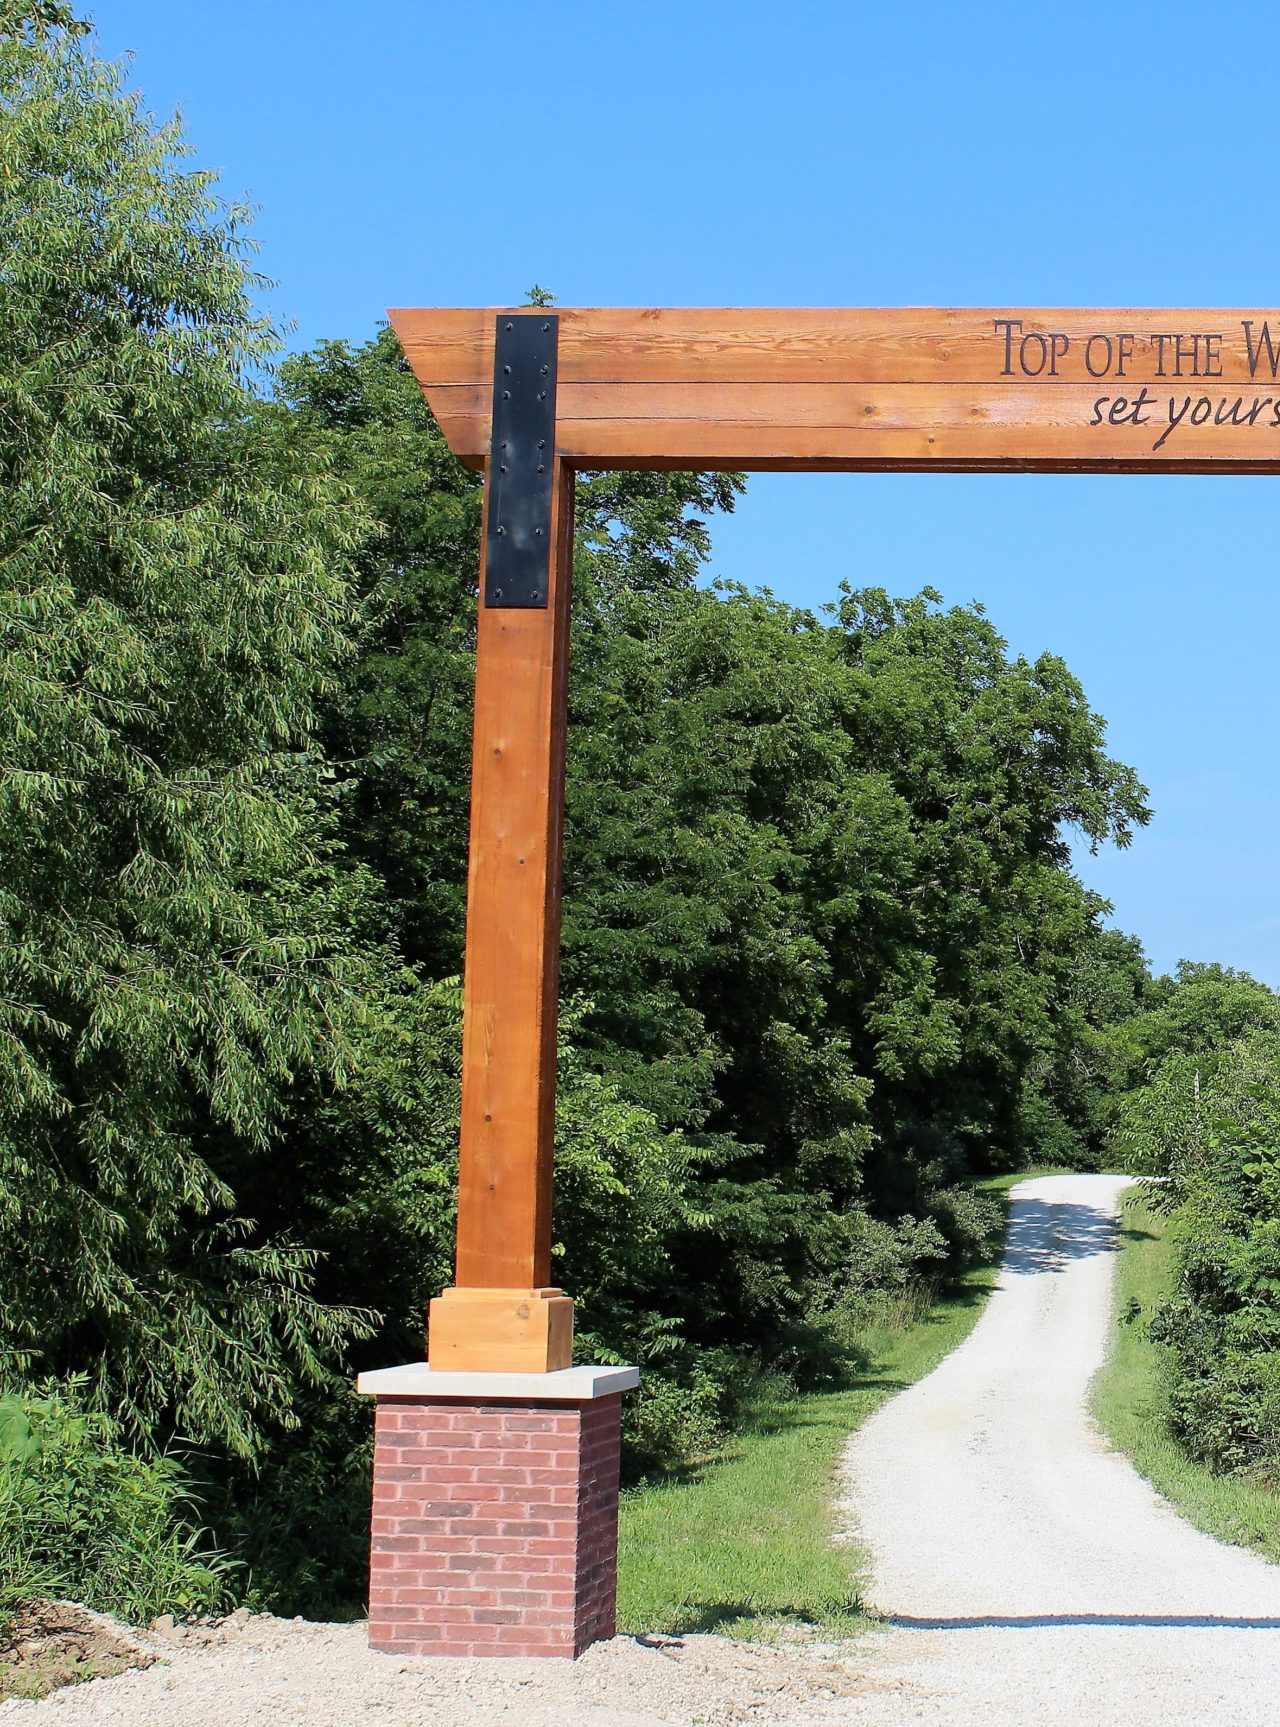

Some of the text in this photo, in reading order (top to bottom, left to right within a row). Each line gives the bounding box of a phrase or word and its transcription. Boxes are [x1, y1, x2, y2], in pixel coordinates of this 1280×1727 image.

[994, 319, 1070, 377] TOP
[1085, 334, 1135, 378] OF
[1150, 334, 1223, 378] THE
[1089, 387, 1158, 426] set
